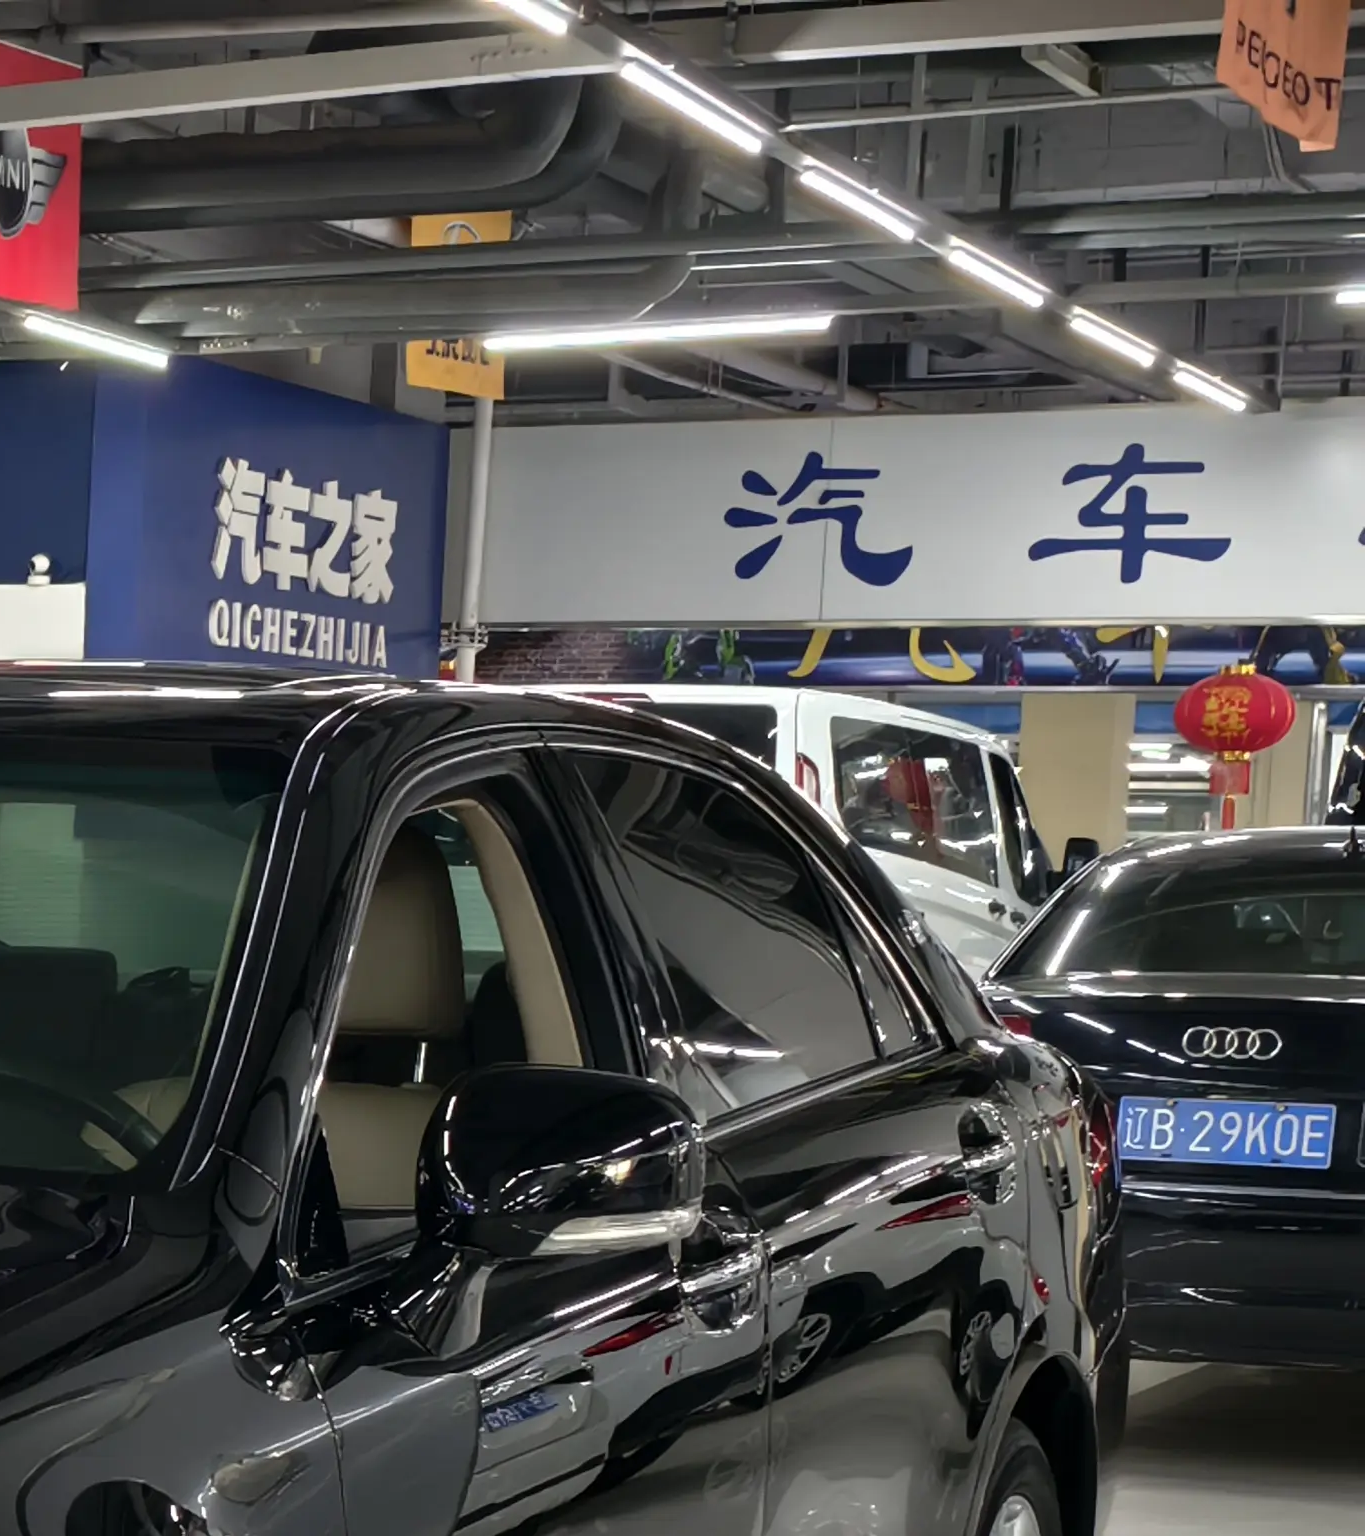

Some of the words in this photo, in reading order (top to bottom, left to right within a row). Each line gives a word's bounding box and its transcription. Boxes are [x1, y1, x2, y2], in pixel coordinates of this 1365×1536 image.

[210, 457, 398, 604] 汽车之家
[723, 442, 1365, 586] 汽车
[208, 598, 388, 669] QICHEZHIJIA
